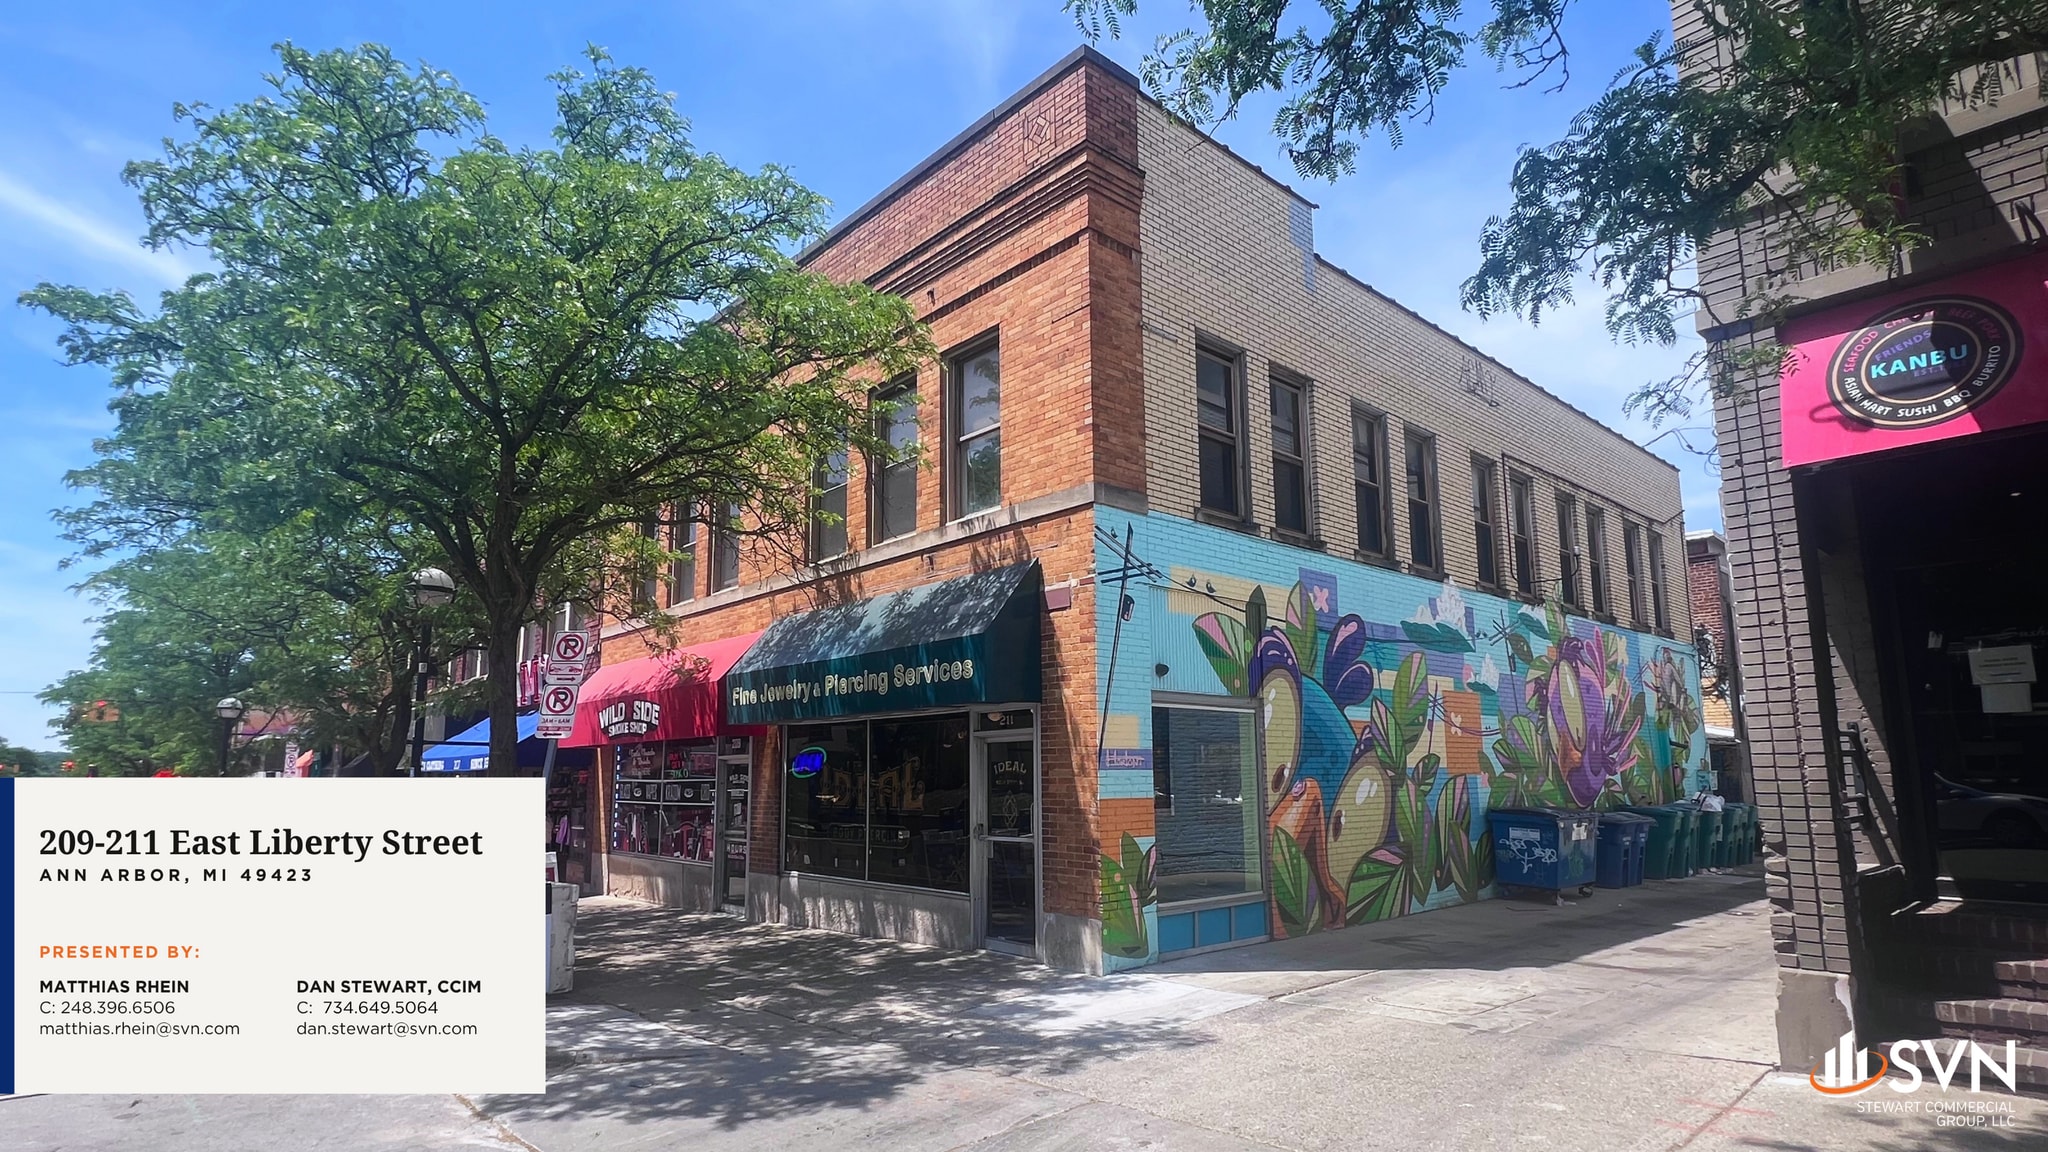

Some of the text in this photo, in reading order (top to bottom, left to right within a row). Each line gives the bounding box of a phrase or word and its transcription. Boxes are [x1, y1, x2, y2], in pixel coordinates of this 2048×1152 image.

[1843, 330, 1879, 373] SEAFOOD
[1871, 344, 1968, 379] KANBU
[1874, 329, 1932, 362] FRIENDS
[1843, 344, 2001, 418] ASIAN MART SUSHI BBQ BURRITO
[732, 658, 974, 707] Fine Jewelry & Piercing Services
[598, 700, 661, 729] WILD SIDE
[608, 721, 648, 737] SMOKE SHOP
[999, 714, 1014, 726] 211
[818, 756, 926, 812] IDEAL
[993, 760, 1028, 775] IDEAL
